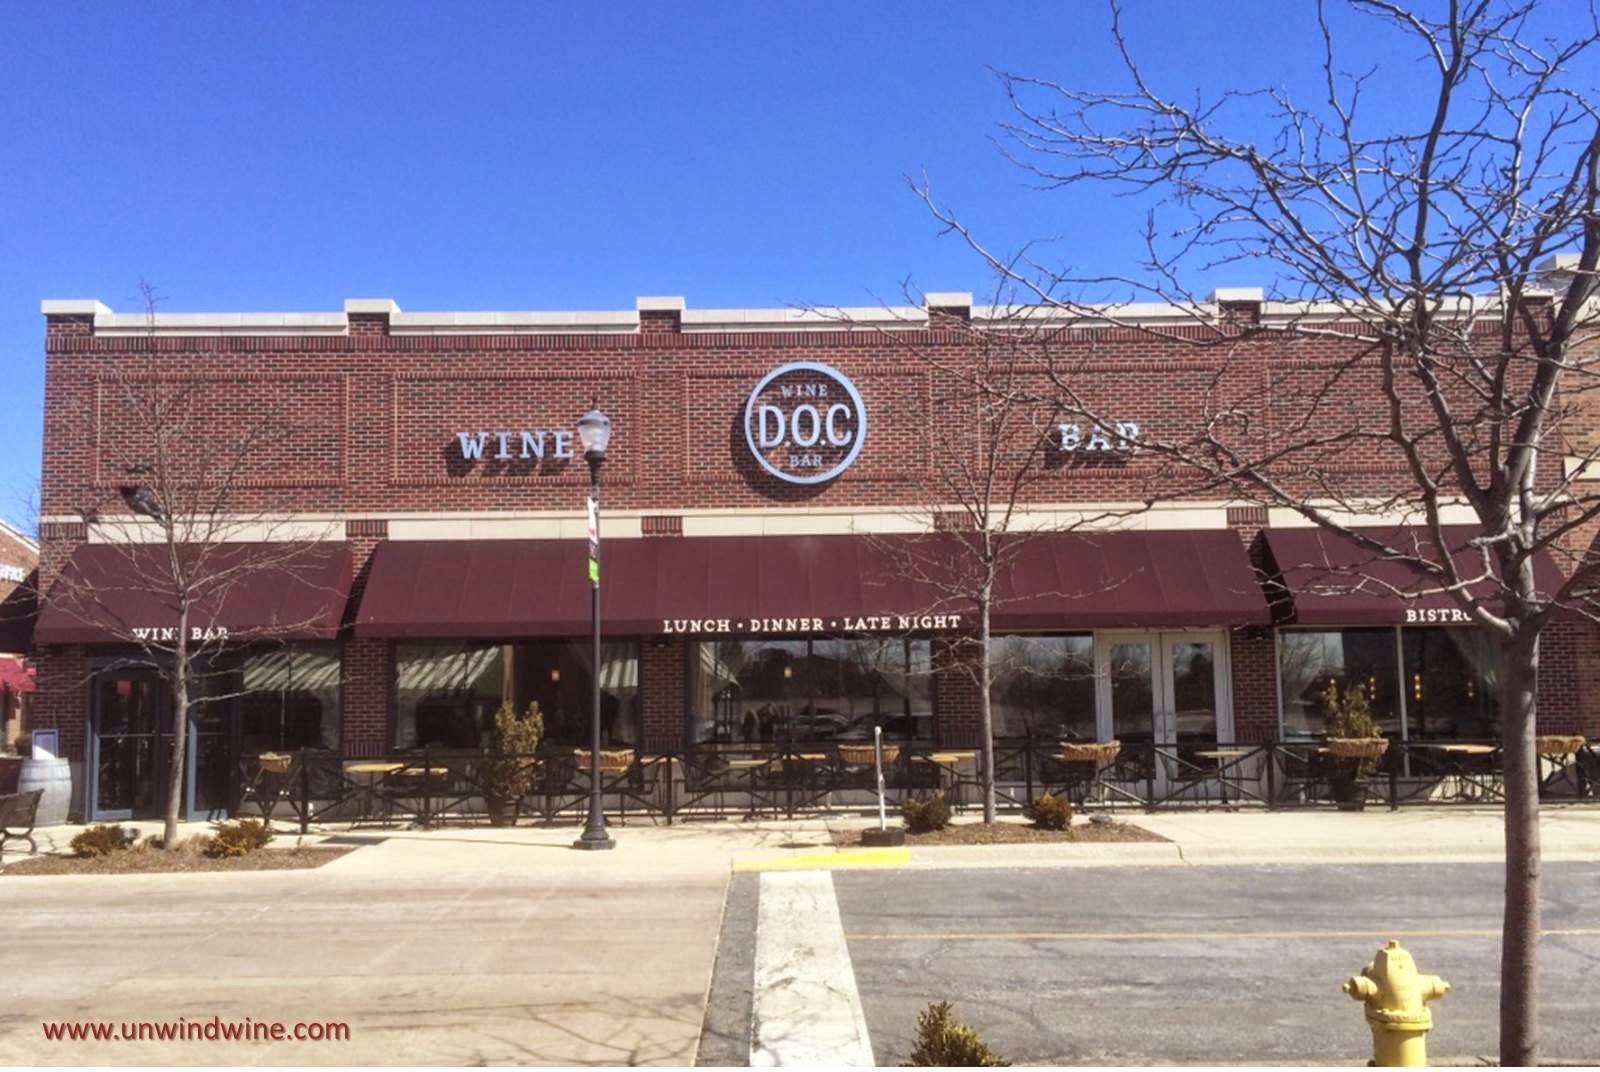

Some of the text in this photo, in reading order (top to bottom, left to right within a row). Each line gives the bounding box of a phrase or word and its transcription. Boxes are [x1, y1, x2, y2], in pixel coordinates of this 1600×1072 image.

[780, 384, 828, 398] WINE
[456, 431, 576, 460] WINE
[788, 455, 824, 468] BAR
[663, 615, 961, 633] LUNCH DINNER LATE NIGHT
[131, 626, 229, 641] WIN BAR
